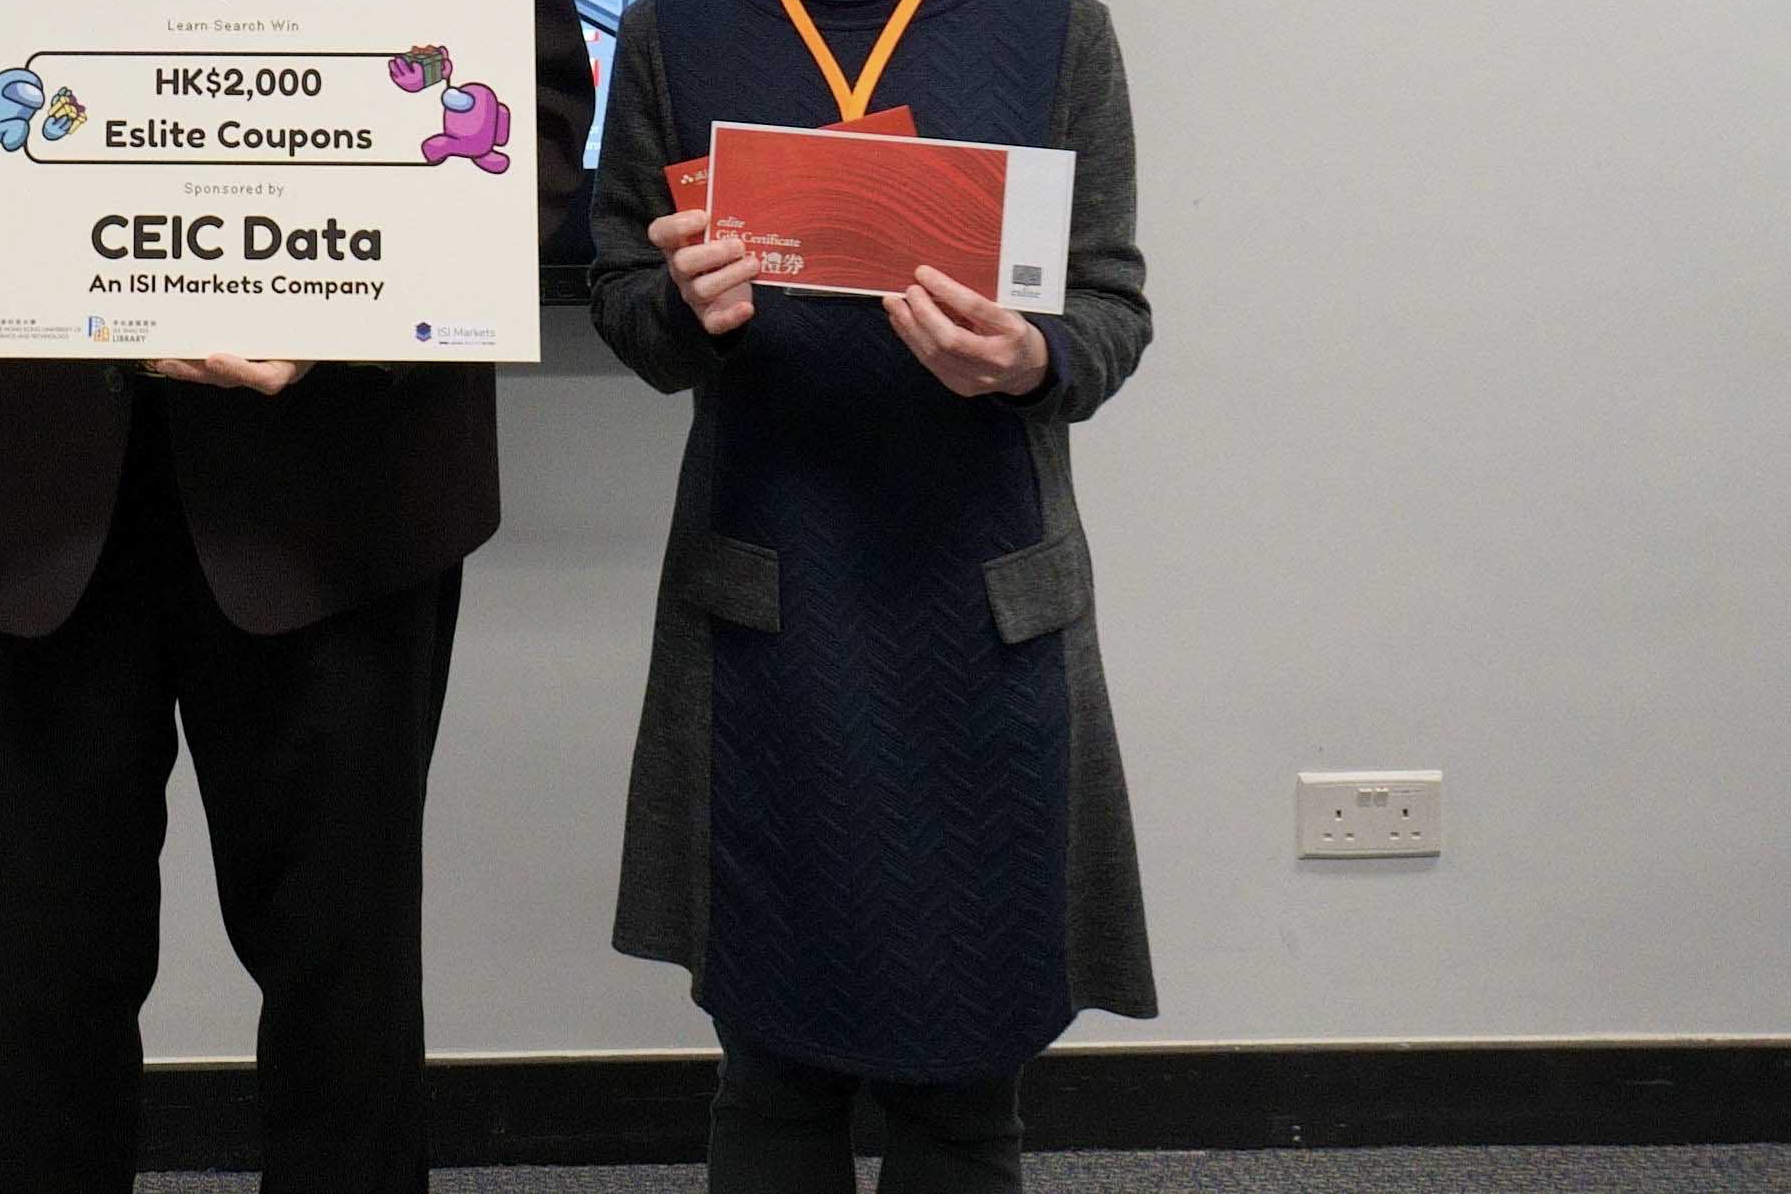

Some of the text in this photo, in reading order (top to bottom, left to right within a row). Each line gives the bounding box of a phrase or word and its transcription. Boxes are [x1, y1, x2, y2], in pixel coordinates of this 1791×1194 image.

[167, 19, 300, 32] Learn Search Win
[155, 67, 322, 100] HK$2,000
[105, 118, 373, 157] Eslite Coupons
[184, 182, 285, 198] Sponsored by
[91, 215, 382, 261] CEIC Data
[741, 231, 802, 248] Certificate
[89, 275, 384, 299] An ISI Markets Company
